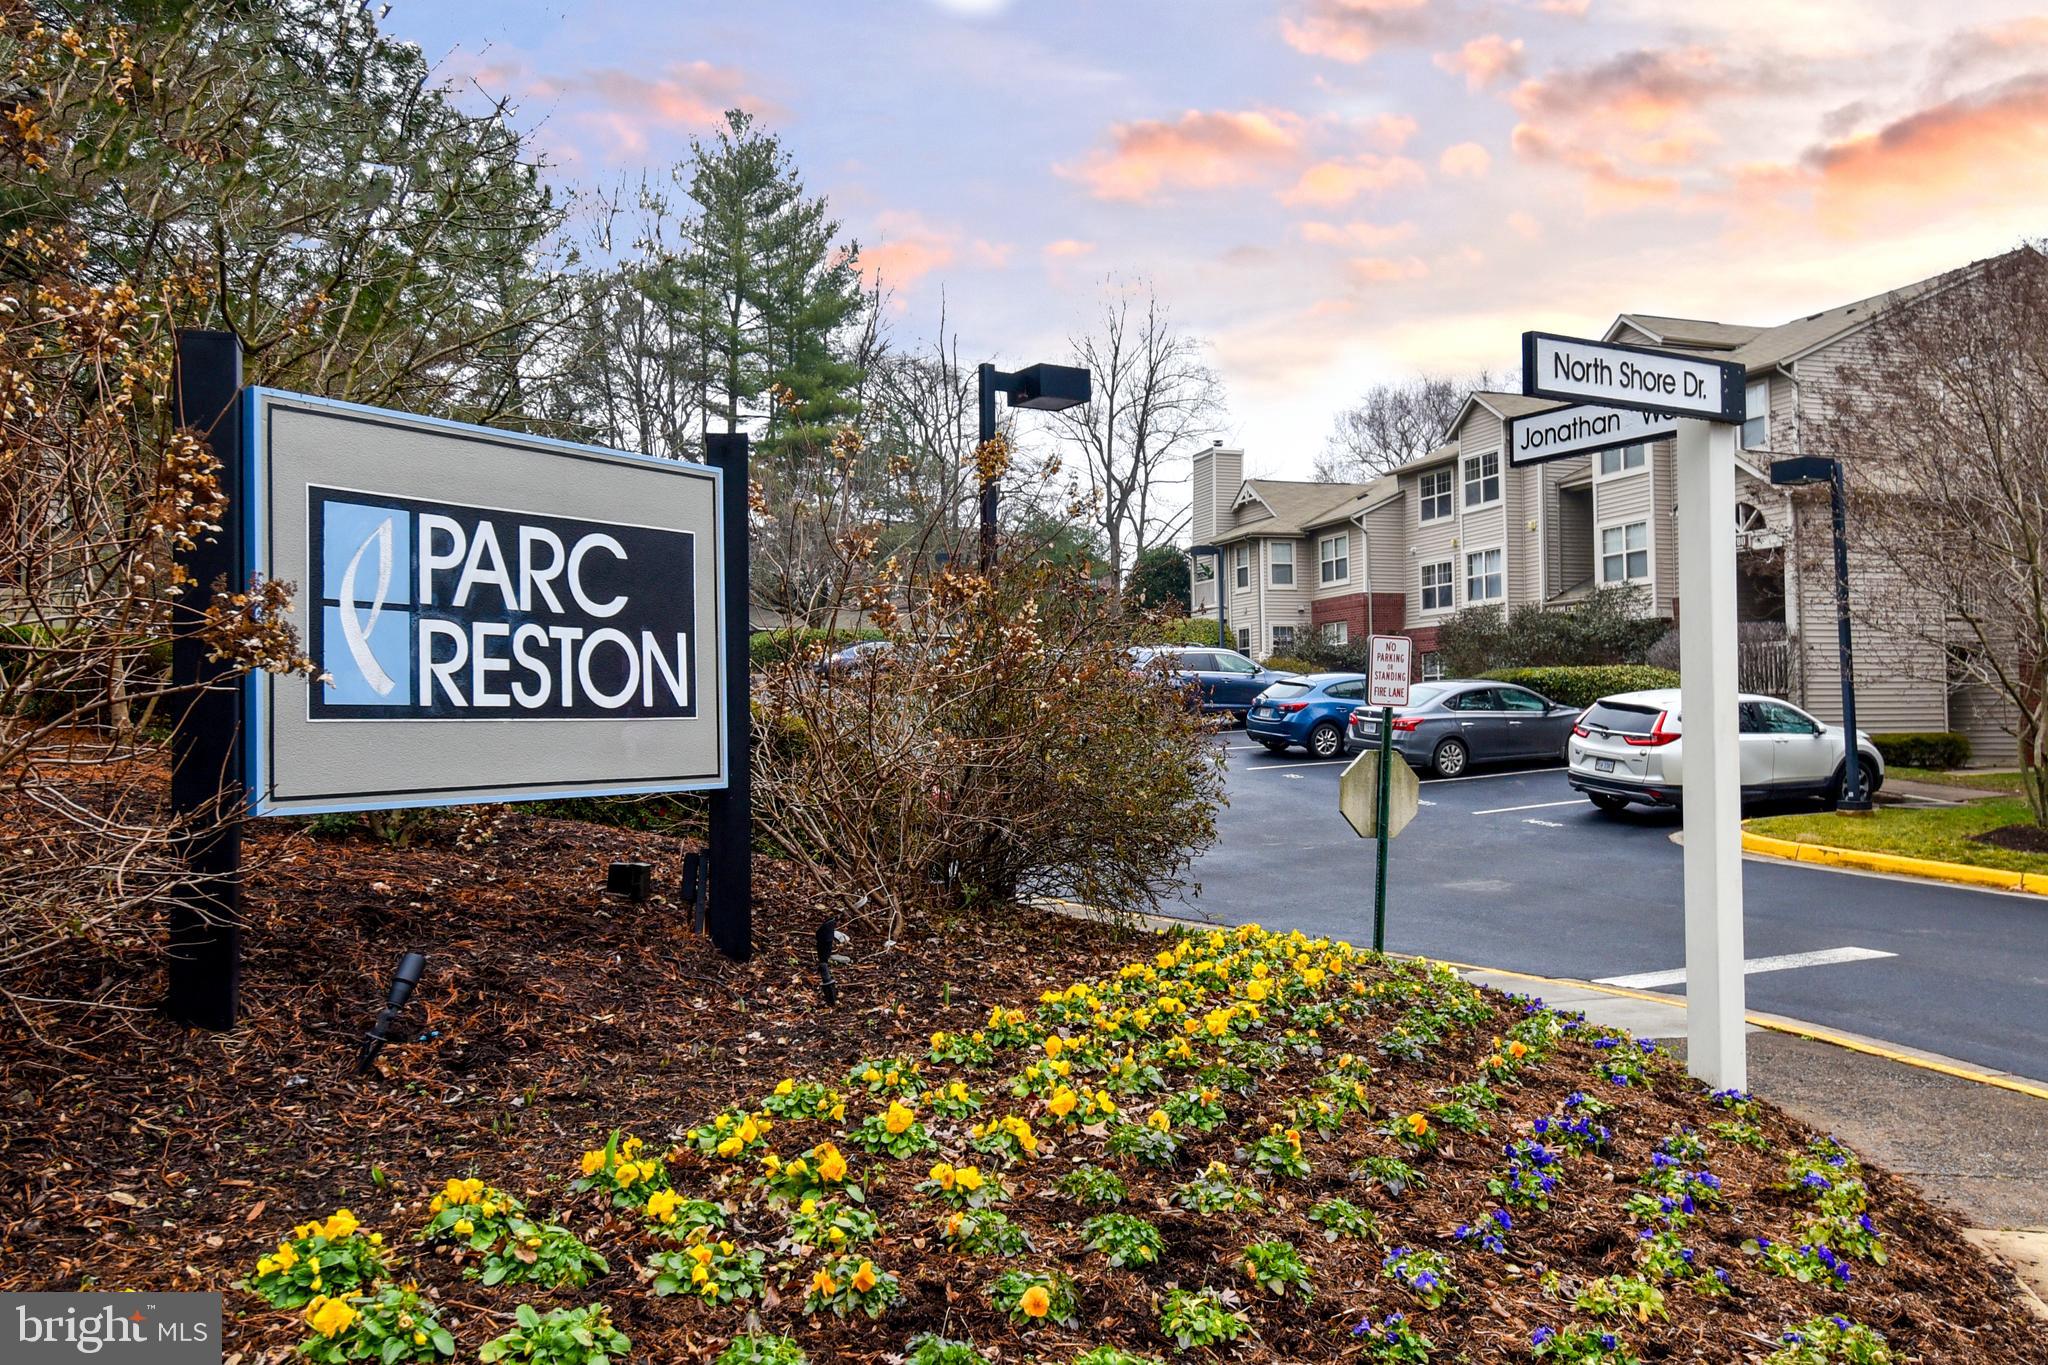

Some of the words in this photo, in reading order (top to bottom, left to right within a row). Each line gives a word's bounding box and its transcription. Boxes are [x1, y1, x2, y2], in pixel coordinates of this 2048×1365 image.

[1554, 351, 1612, 386] North
[1619, 360, 1676, 394] Shore
[1684, 371, 1706, 399] Dr.
[1520, 414, 1620, 450] Jonathan
[418, 513, 629, 618] PARC
[1377, 653, 1404, 663] PARKING
[1385, 642, 1396, 652] NO
[418, 619, 688, 709] RESTON
[1374, 671, 1406, 681] STANDING
[1374, 687, 1387, 697] FIRE
[1388, 688, 1404, 697] LANE
